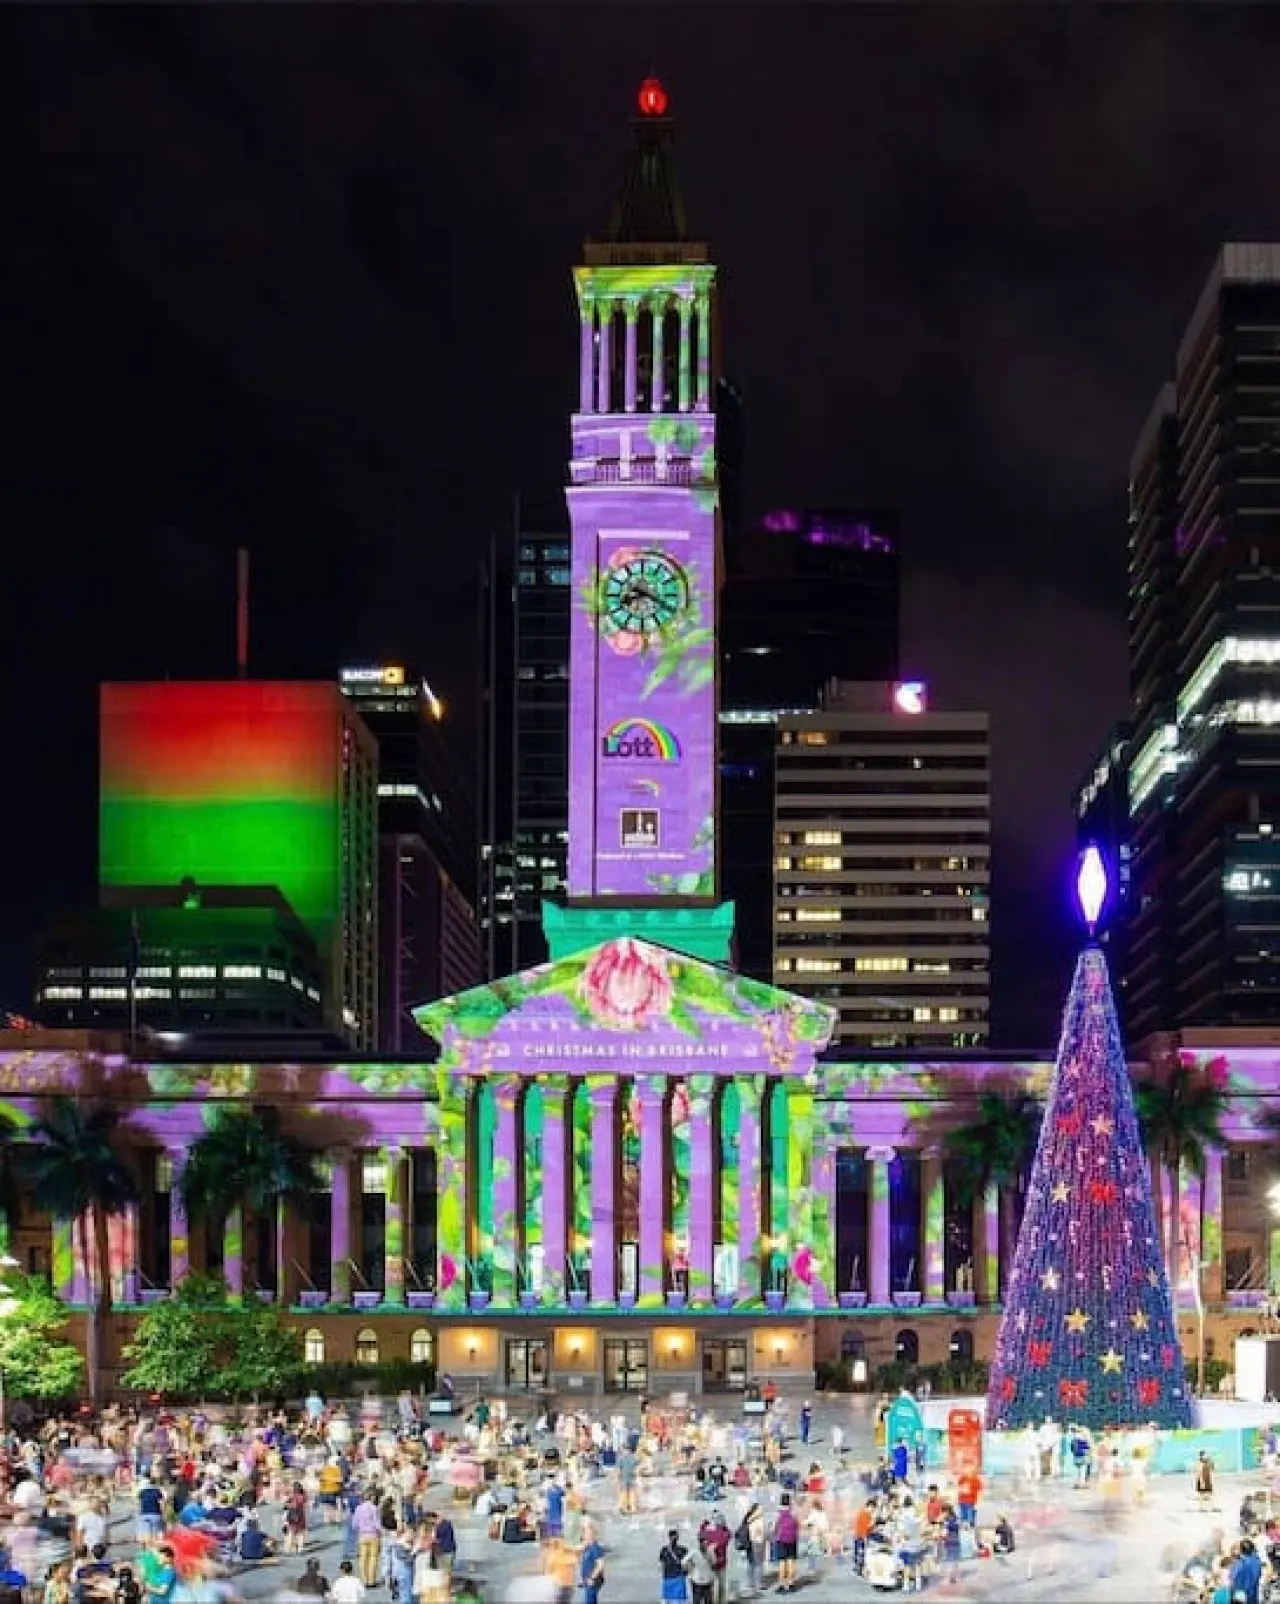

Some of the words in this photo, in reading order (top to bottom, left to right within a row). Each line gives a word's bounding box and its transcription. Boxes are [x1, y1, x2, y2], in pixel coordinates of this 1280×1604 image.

[602, 735, 655, 757] Lott
[523, 1043, 617, 1058] CHRISTMAS
[622, 1043, 641, 1058] IN
[648, 1043, 729, 1058] BRISBANE
